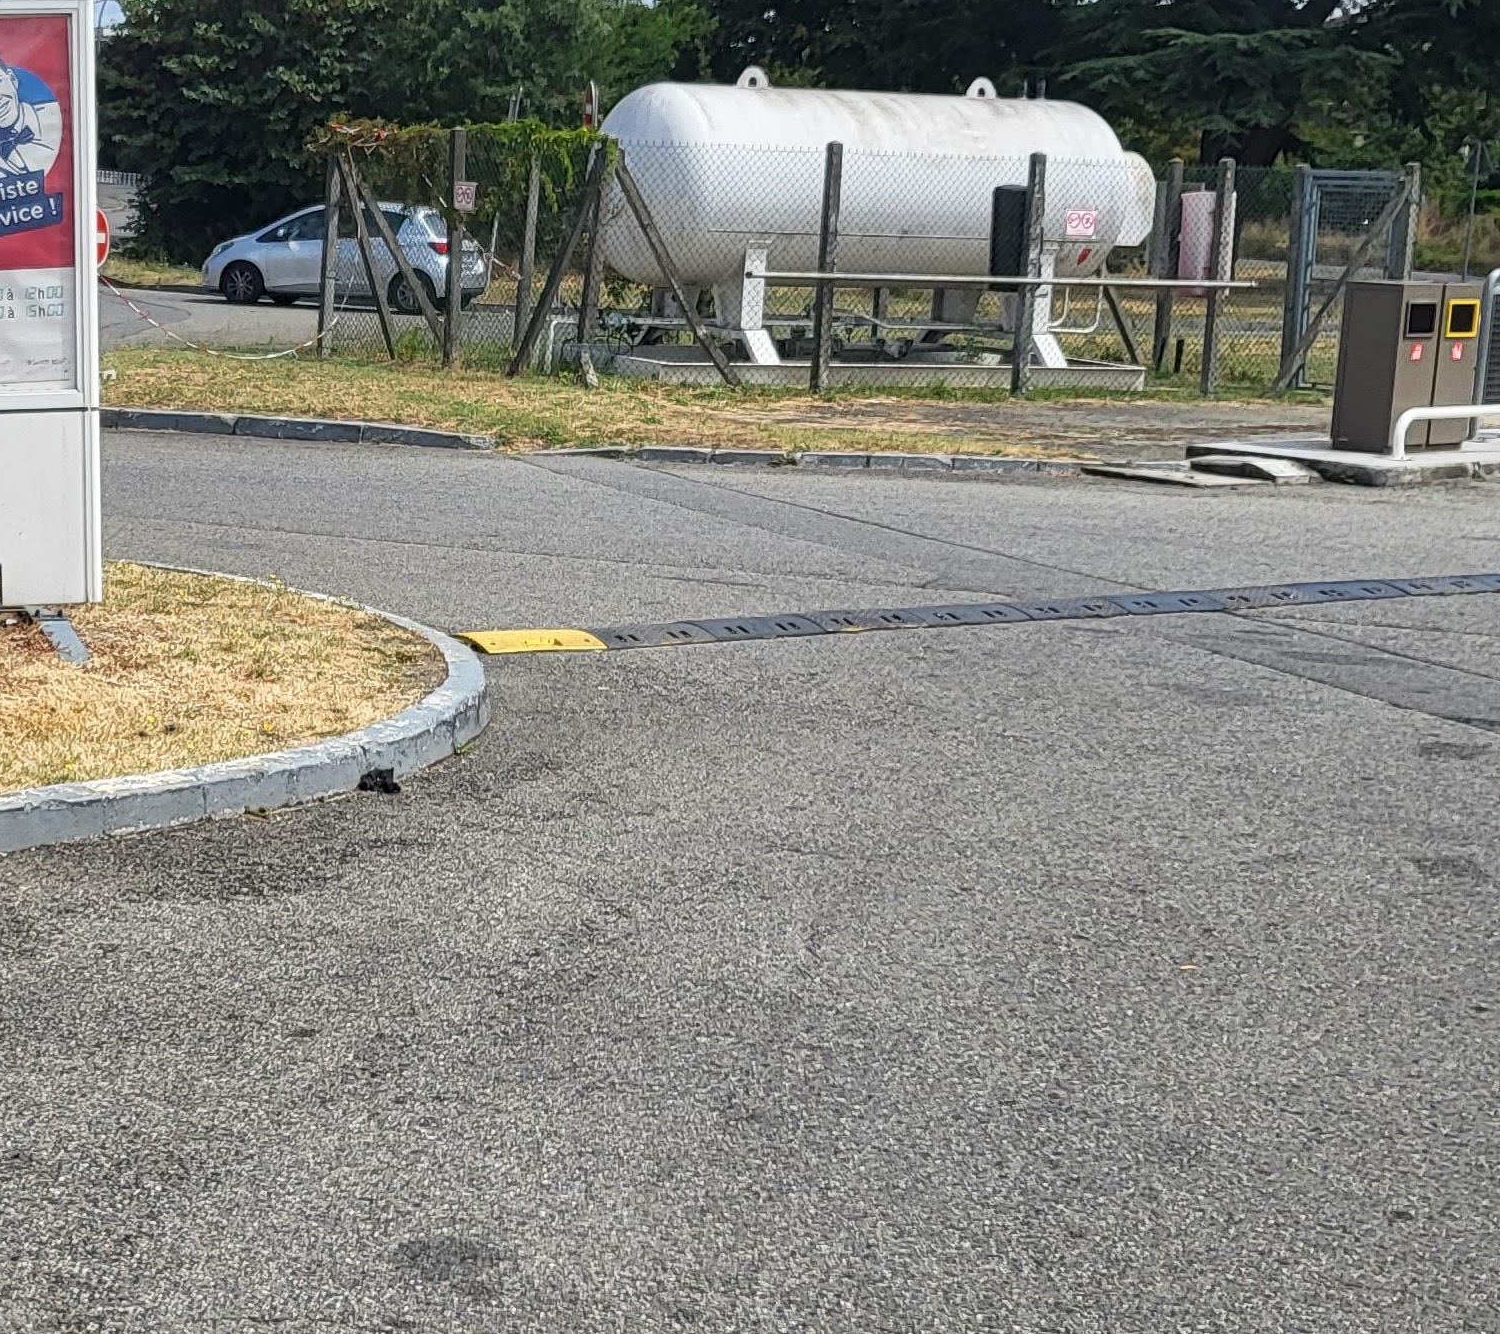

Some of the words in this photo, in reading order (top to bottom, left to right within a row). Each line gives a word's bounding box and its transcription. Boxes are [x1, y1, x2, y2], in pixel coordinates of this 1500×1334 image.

[6, 288, 14, 301] à
[24, 285, 64, 300] 12h00
[7, 305, 15, 319] à
[25, 303, 65, 318] 15h00
